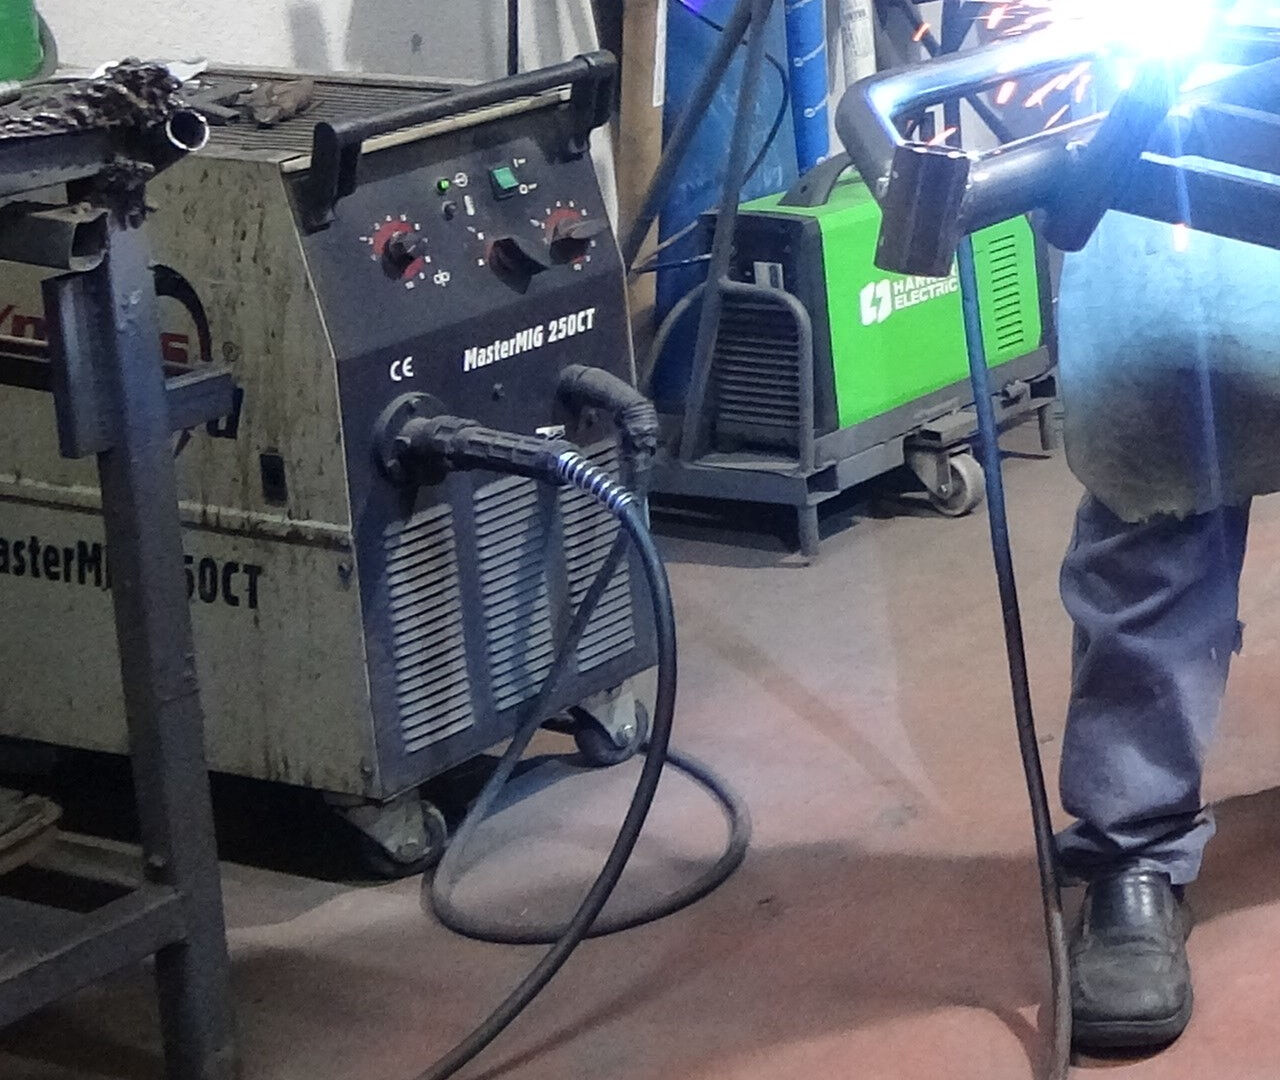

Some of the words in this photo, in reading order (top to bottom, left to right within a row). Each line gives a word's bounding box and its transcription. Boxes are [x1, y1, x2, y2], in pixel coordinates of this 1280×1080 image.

[895, 278, 958, 310] ELECTRIC
[463, 324, 544, 372] MasterMIG
[548, 307, 596, 343] 250CT
